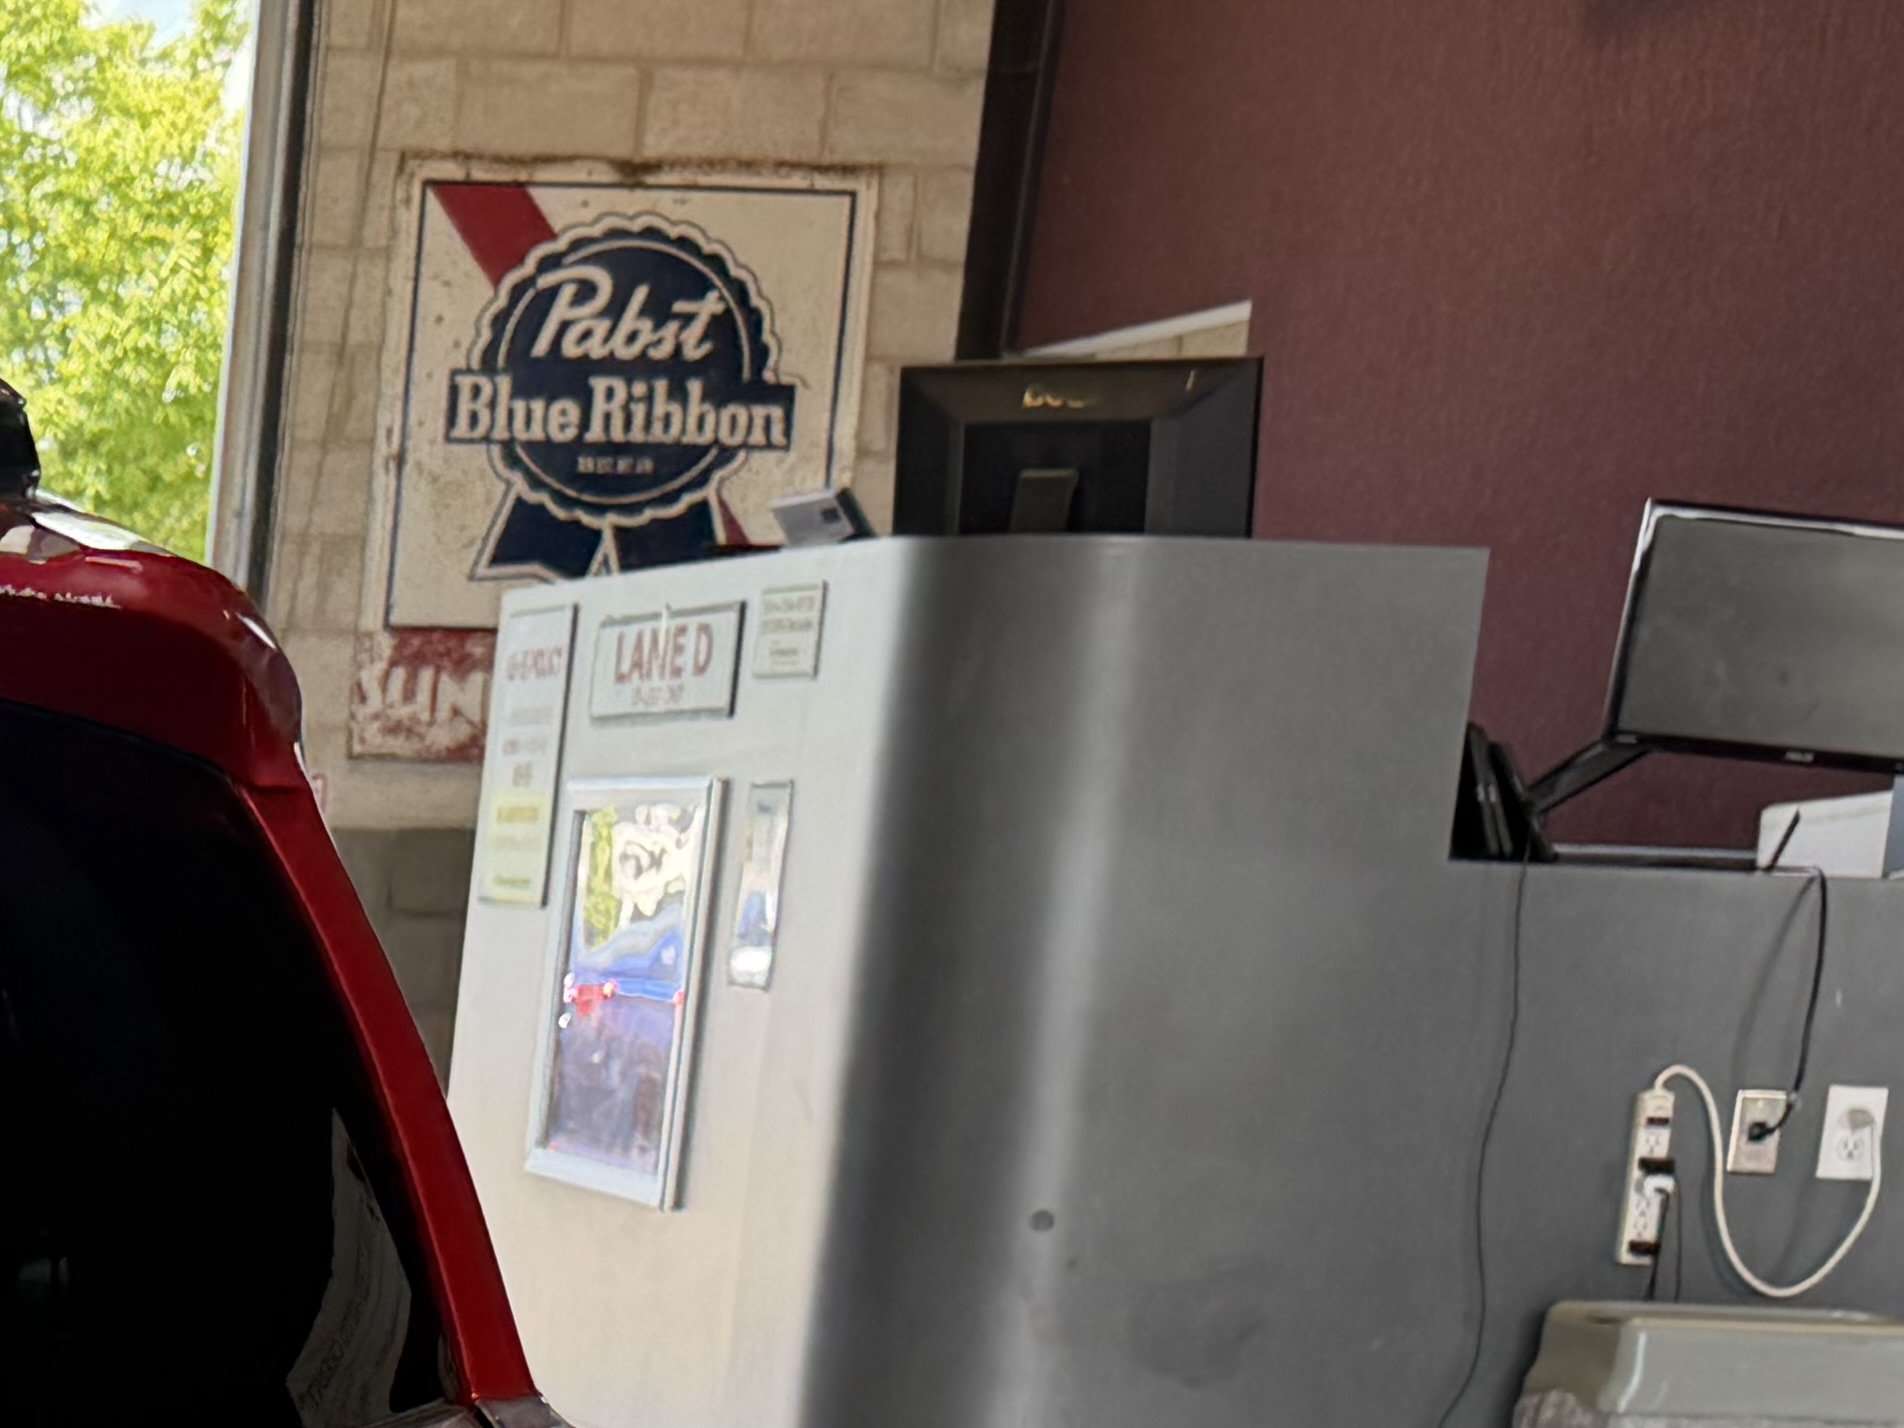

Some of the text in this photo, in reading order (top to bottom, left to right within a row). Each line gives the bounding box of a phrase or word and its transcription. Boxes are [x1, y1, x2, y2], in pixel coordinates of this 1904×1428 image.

[530, 264, 727, 362] Pabst
[450, 374, 789, 447] Blue Ribbon
[614, 624, 689, 684] LANE
[693, 623, 715, 676] D
